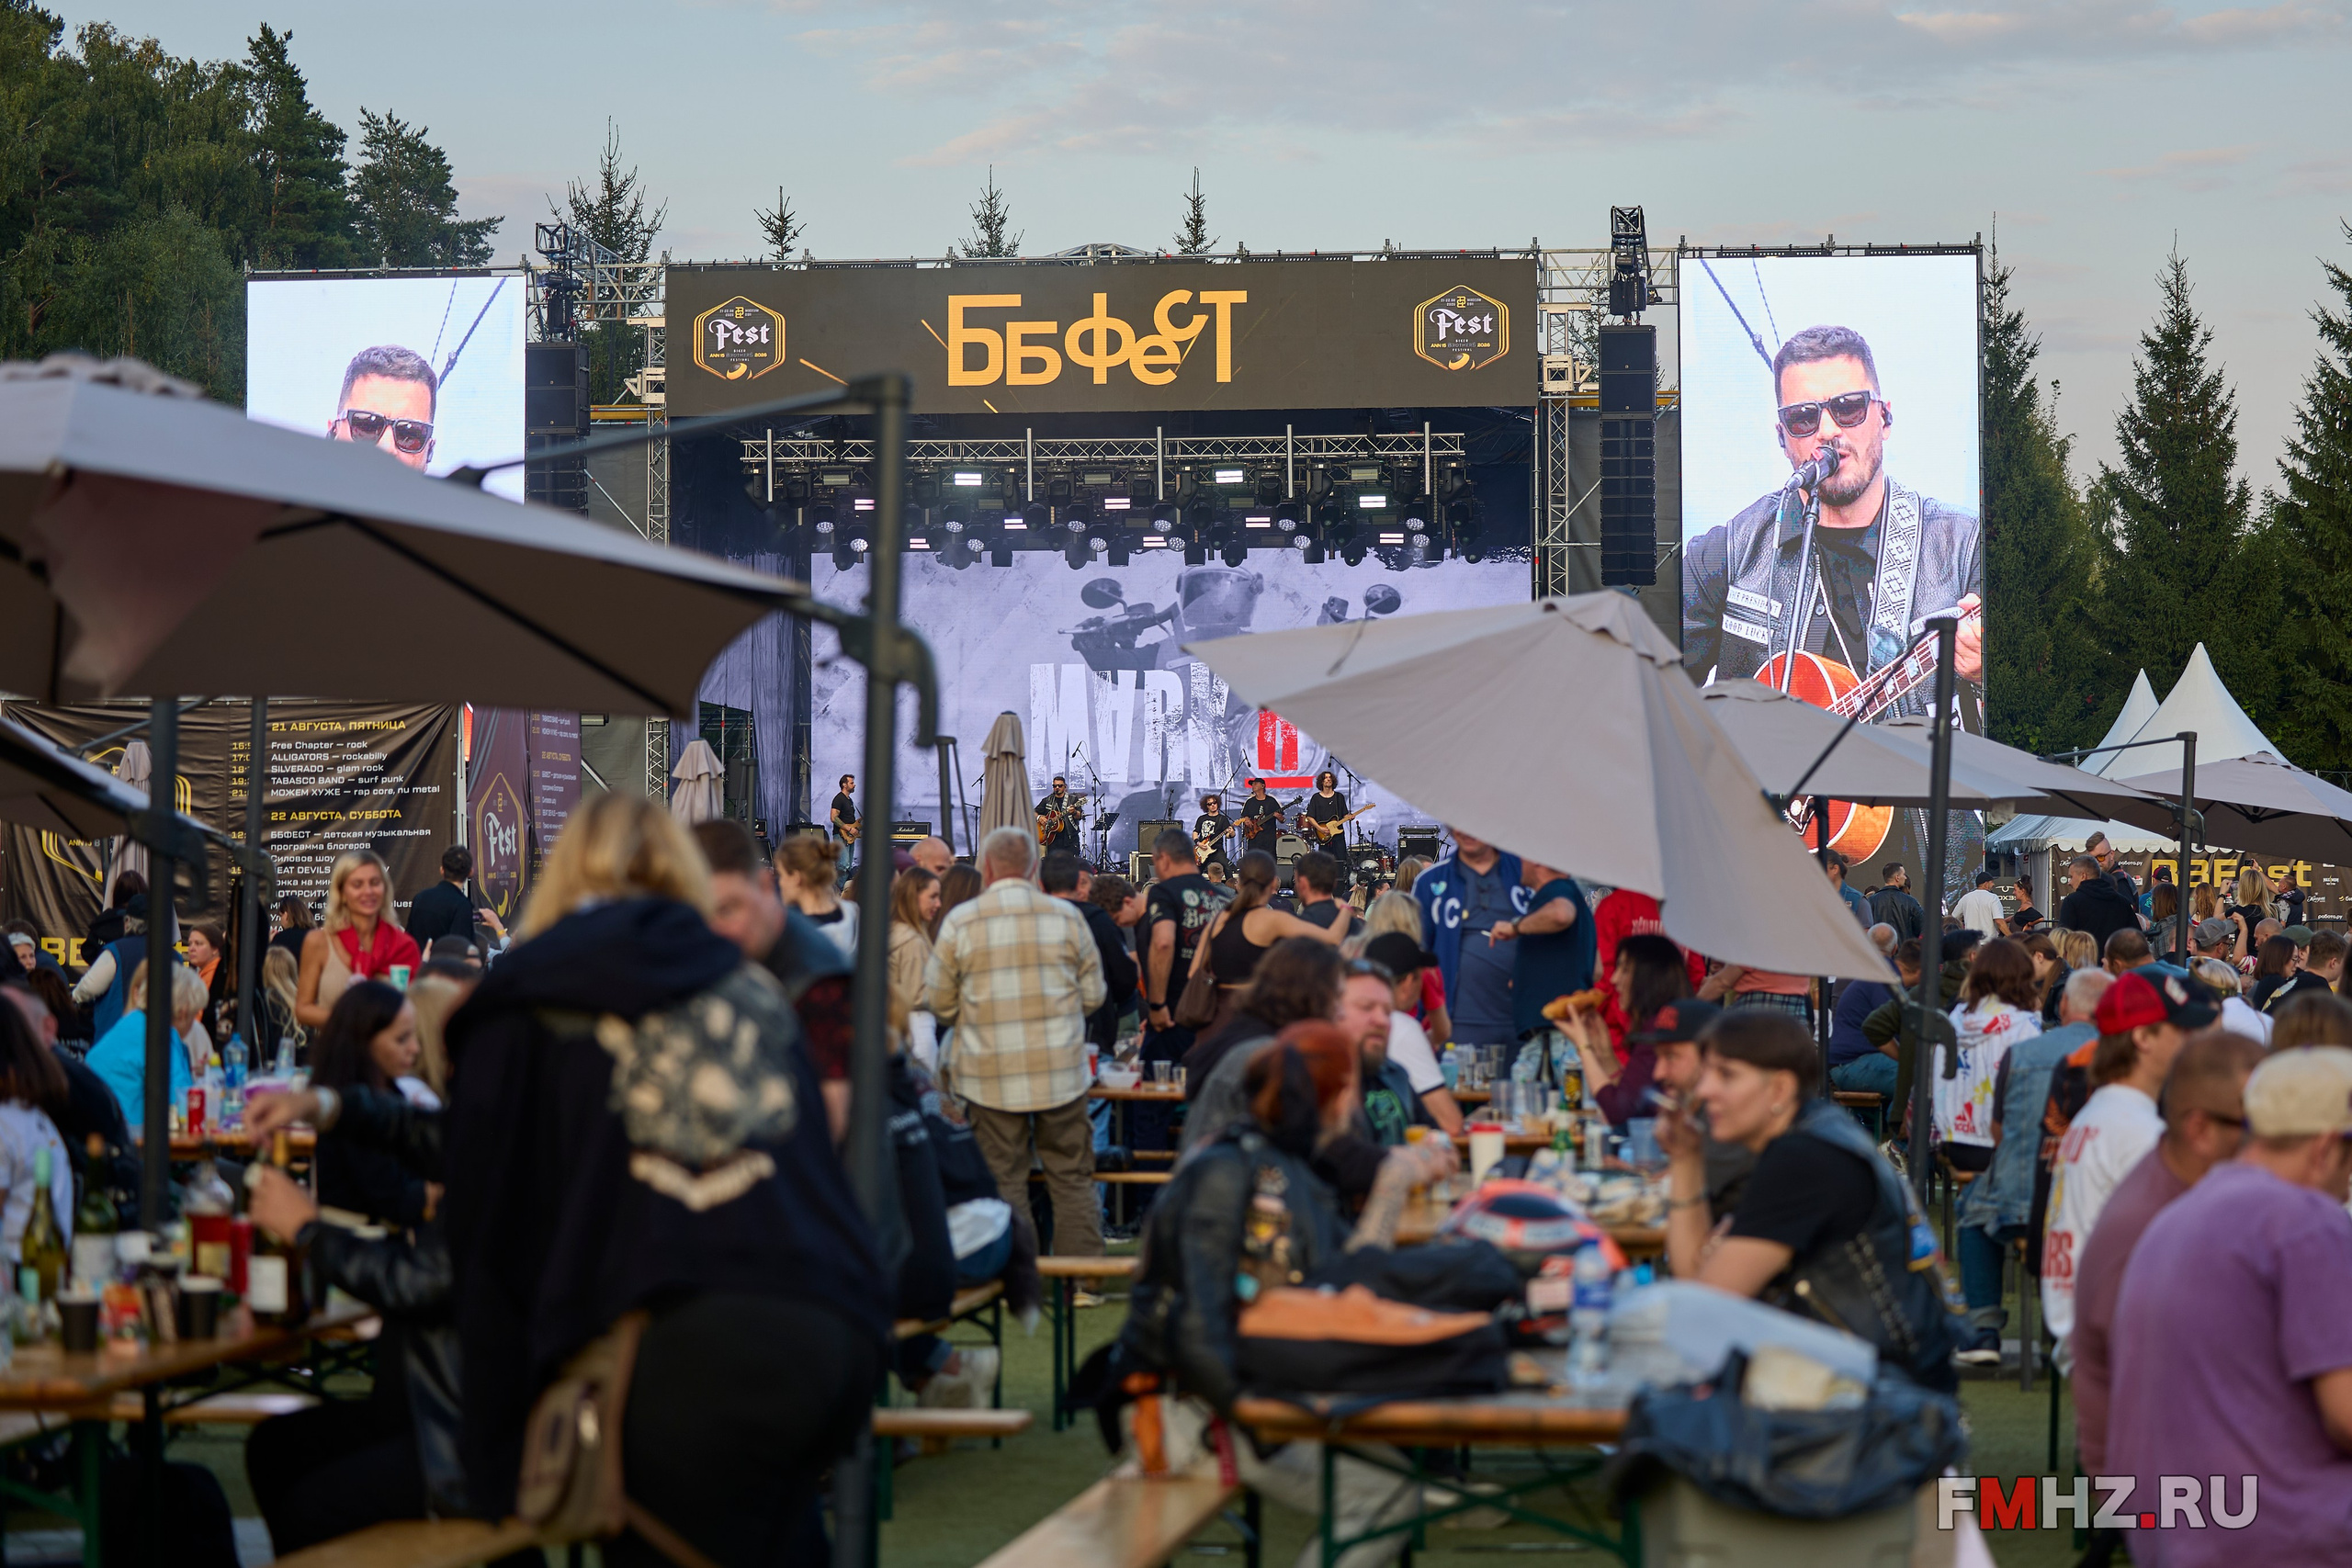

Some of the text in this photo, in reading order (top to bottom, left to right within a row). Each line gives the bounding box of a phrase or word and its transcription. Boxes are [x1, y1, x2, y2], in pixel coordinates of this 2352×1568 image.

[1430, 309, 1494, 342] Fest
[708, 319, 770, 351] Fest
[1725, 619, 1742, 632] GOOD
[272, 720, 406, 732] 21 АВГУСТА, ПЯТНИЦА
[295, 741, 334, 750] Chapter
[346, 740, 368, 749] rock
[271, 753, 329, 761] ALLIGATORS
[342, 752, 388, 761] rockabilly
[271, 764, 323, 773] SILVERADO
[336, 764, 360, 773] glam
[271, 776, 316, 784] TABASCO
[318, 776, 345, 784] BAND
[358, 775, 379, 784] surf
[381, 775, 404, 784] punk
[271, 788, 309, 796] МОЖЕМ
[311, 788, 341, 796] ХУЖЕ
[413, 785, 440, 794] metal
[271, 810, 401, 821] 22 АВГУСТА, СУББОТА
[270, 830, 311, 839] ББФЕСТ
[365, 829, 431, 838] музыкальная
[484, 812, 516, 867] Fest
[270, 842, 371, 852] программа блогеров
[270, 854, 335, 863] Силовое шоу
[277, 866, 331, 874] EAT DEVILS
